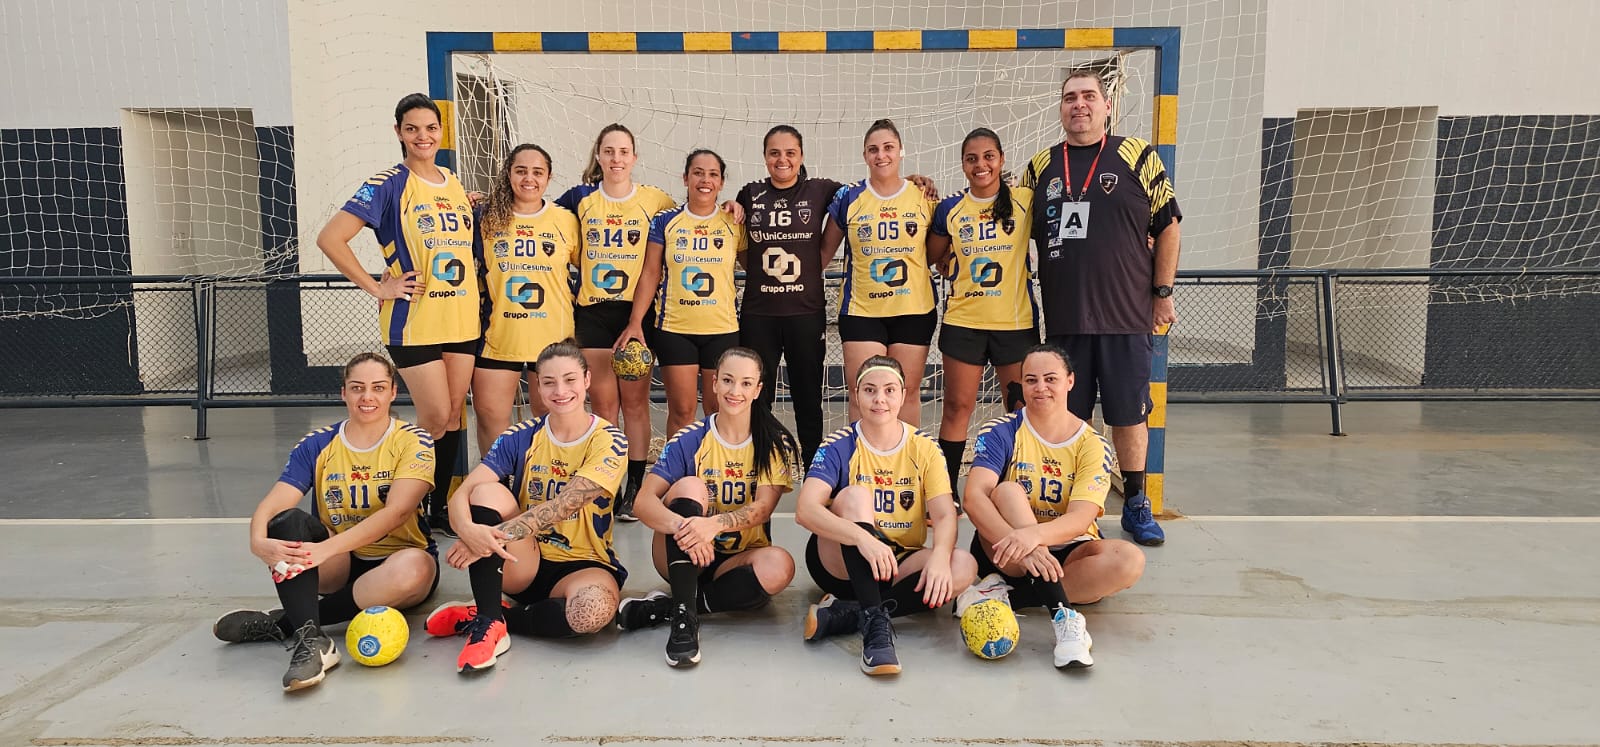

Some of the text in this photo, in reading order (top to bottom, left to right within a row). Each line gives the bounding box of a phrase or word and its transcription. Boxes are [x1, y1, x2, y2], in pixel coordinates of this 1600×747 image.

[438, 213, 459, 232] 15
[769, 210, 792, 227] 16
[1065, 212, 1083, 228] A
[762, 231, 814, 240] UniCesumar
[878, 221, 899, 240] 05
[978, 221, 997, 240] 12
[436, 238, 471, 247] UniCesuma
[603, 228, 623, 247] 14
[514, 239, 536, 257] 20
[692, 237, 708, 251] 10
[873, 246, 915, 254] UniCesumar
[972, 244, 1013, 254] UniCesumar
[597, 252, 638, 260] UniCesumar
[685, 255, 723, 263] UniCesumar
[510, 263, 552, 271] UniCesumar
[429, 289, 456, 298] Grupo
[760, 284, 804, 293] Grupo FMO
[869, 290, 894, 299] Grupo
[679, 298, 700, 306] Grupo
[349, 484, 370, 509] 11
[722, 481, 746, 505] 03
[1039, 477, 1062, 504] 13
[874, 489, 895, 514] 08
[875, 520, 913, 529] iCesumar
